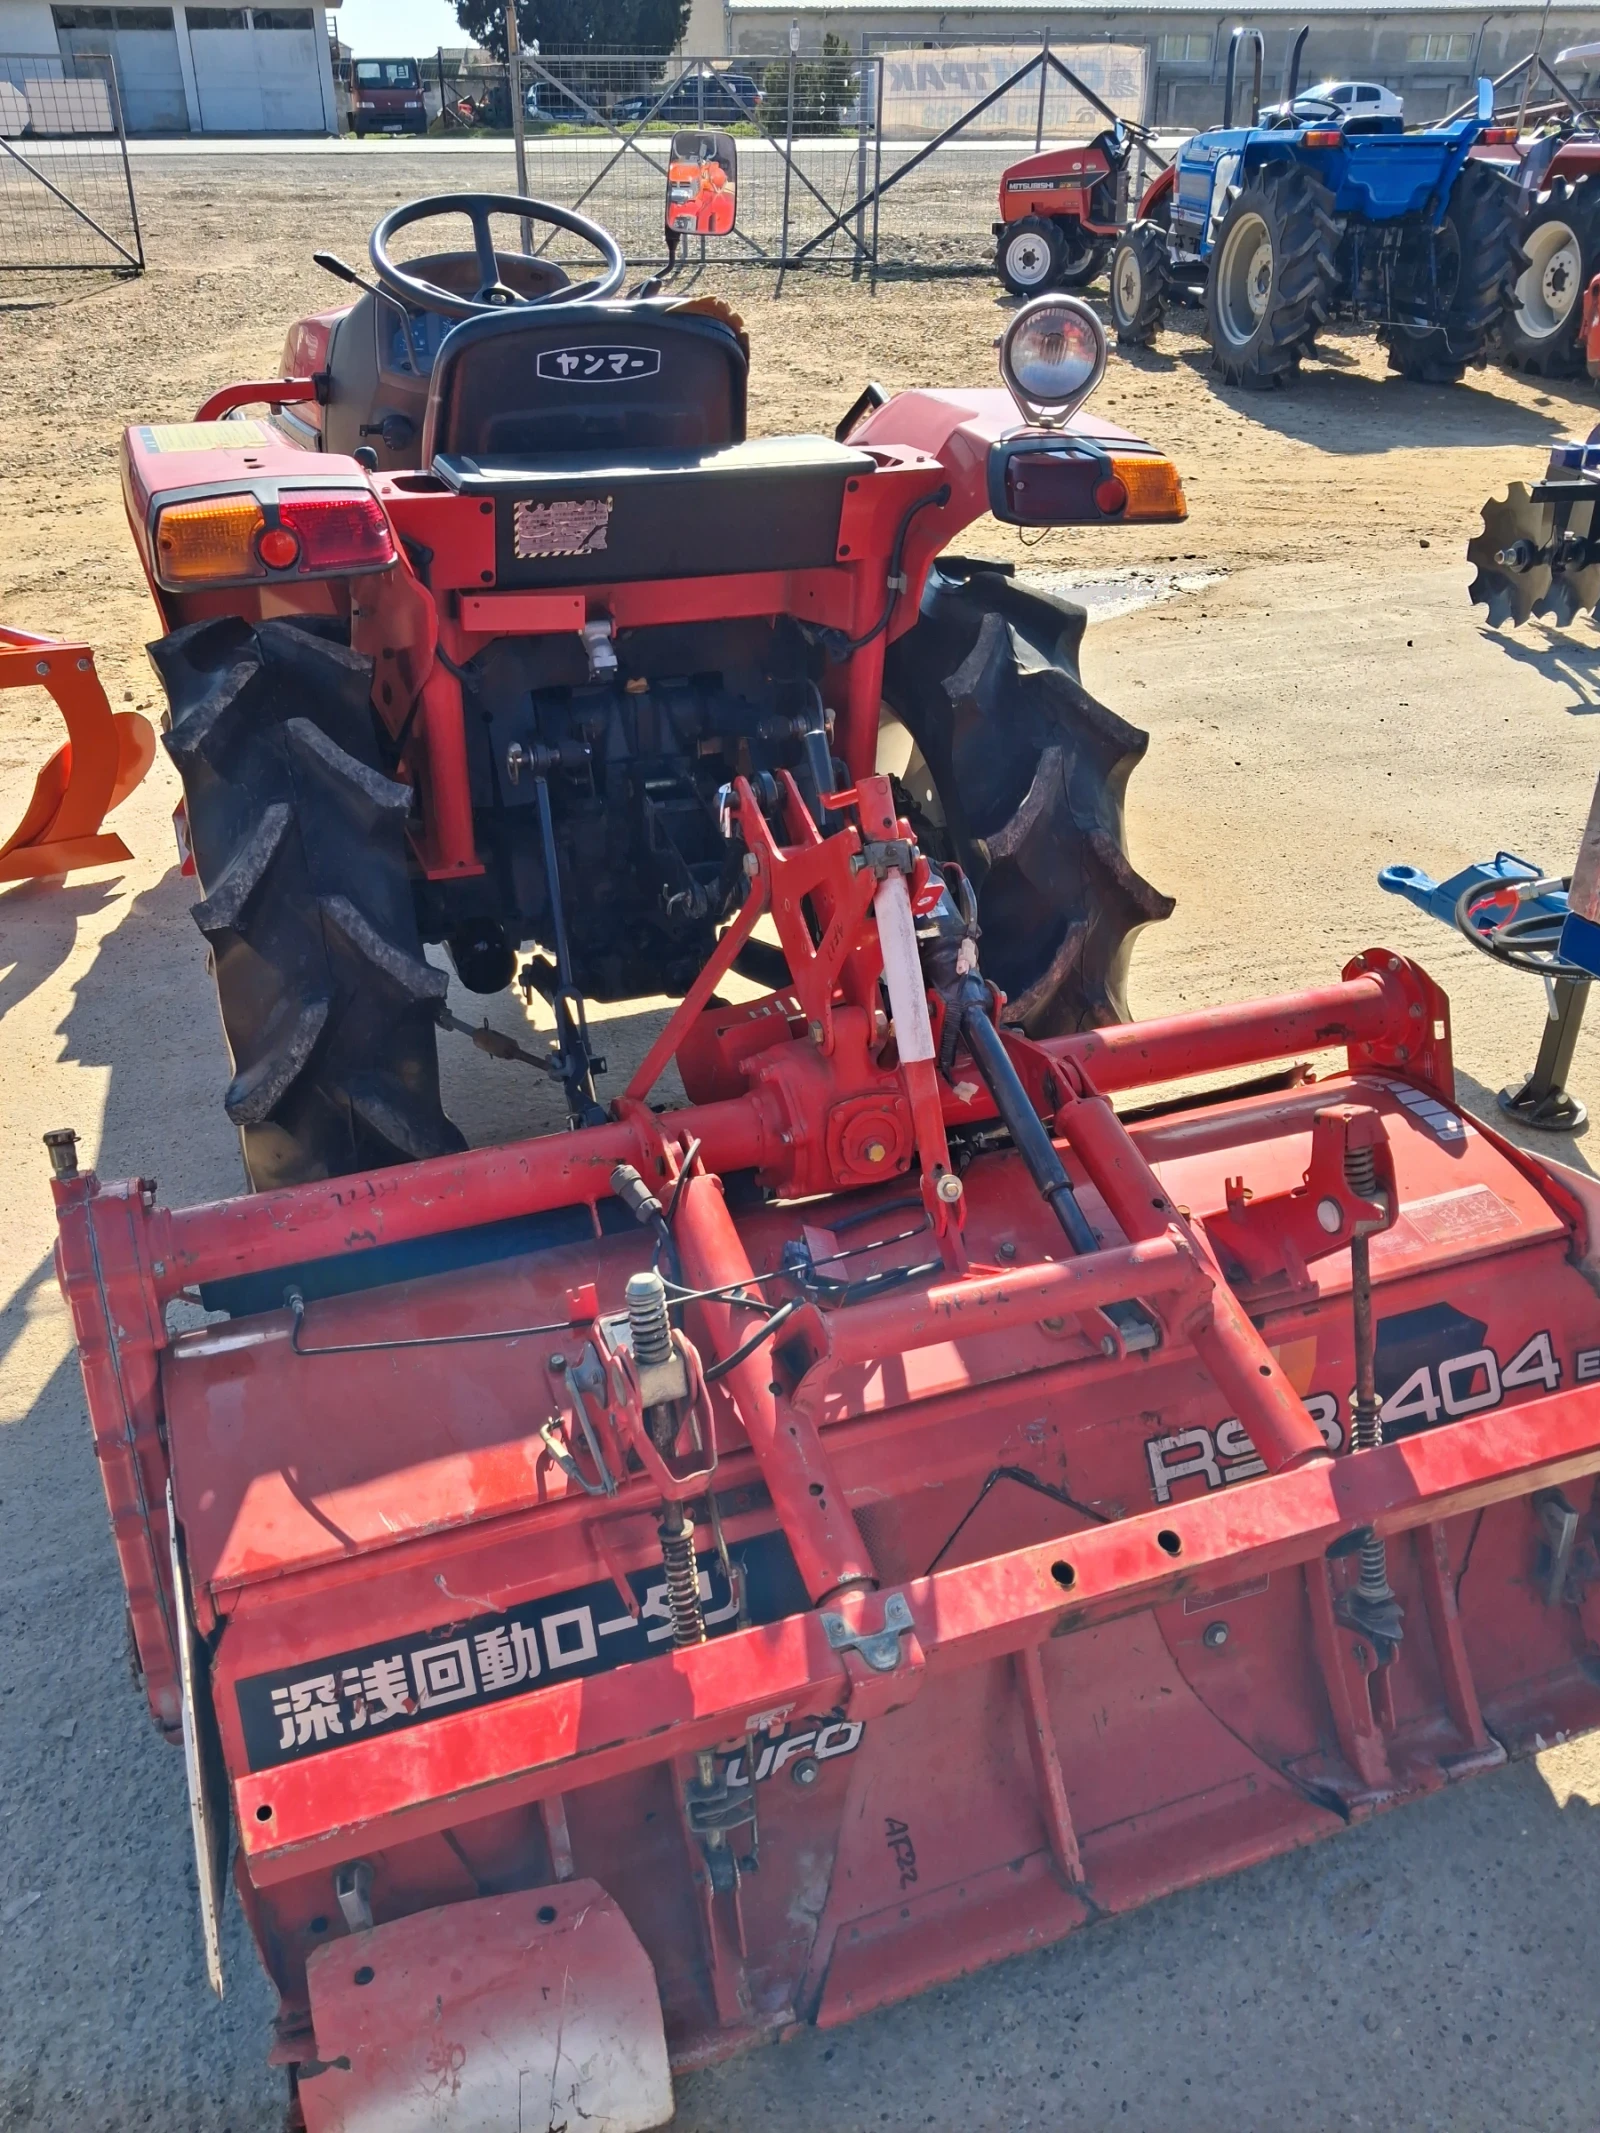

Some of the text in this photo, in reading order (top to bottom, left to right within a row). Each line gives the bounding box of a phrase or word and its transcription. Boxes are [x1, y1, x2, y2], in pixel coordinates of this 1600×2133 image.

[1009, 182, 1054, 190] MITSUBISHI
[556, 353, 644, 376] ヤンマー
[726, 1721, 863, 1787] UFO
[884, 1816, 918, 1891] AF22
